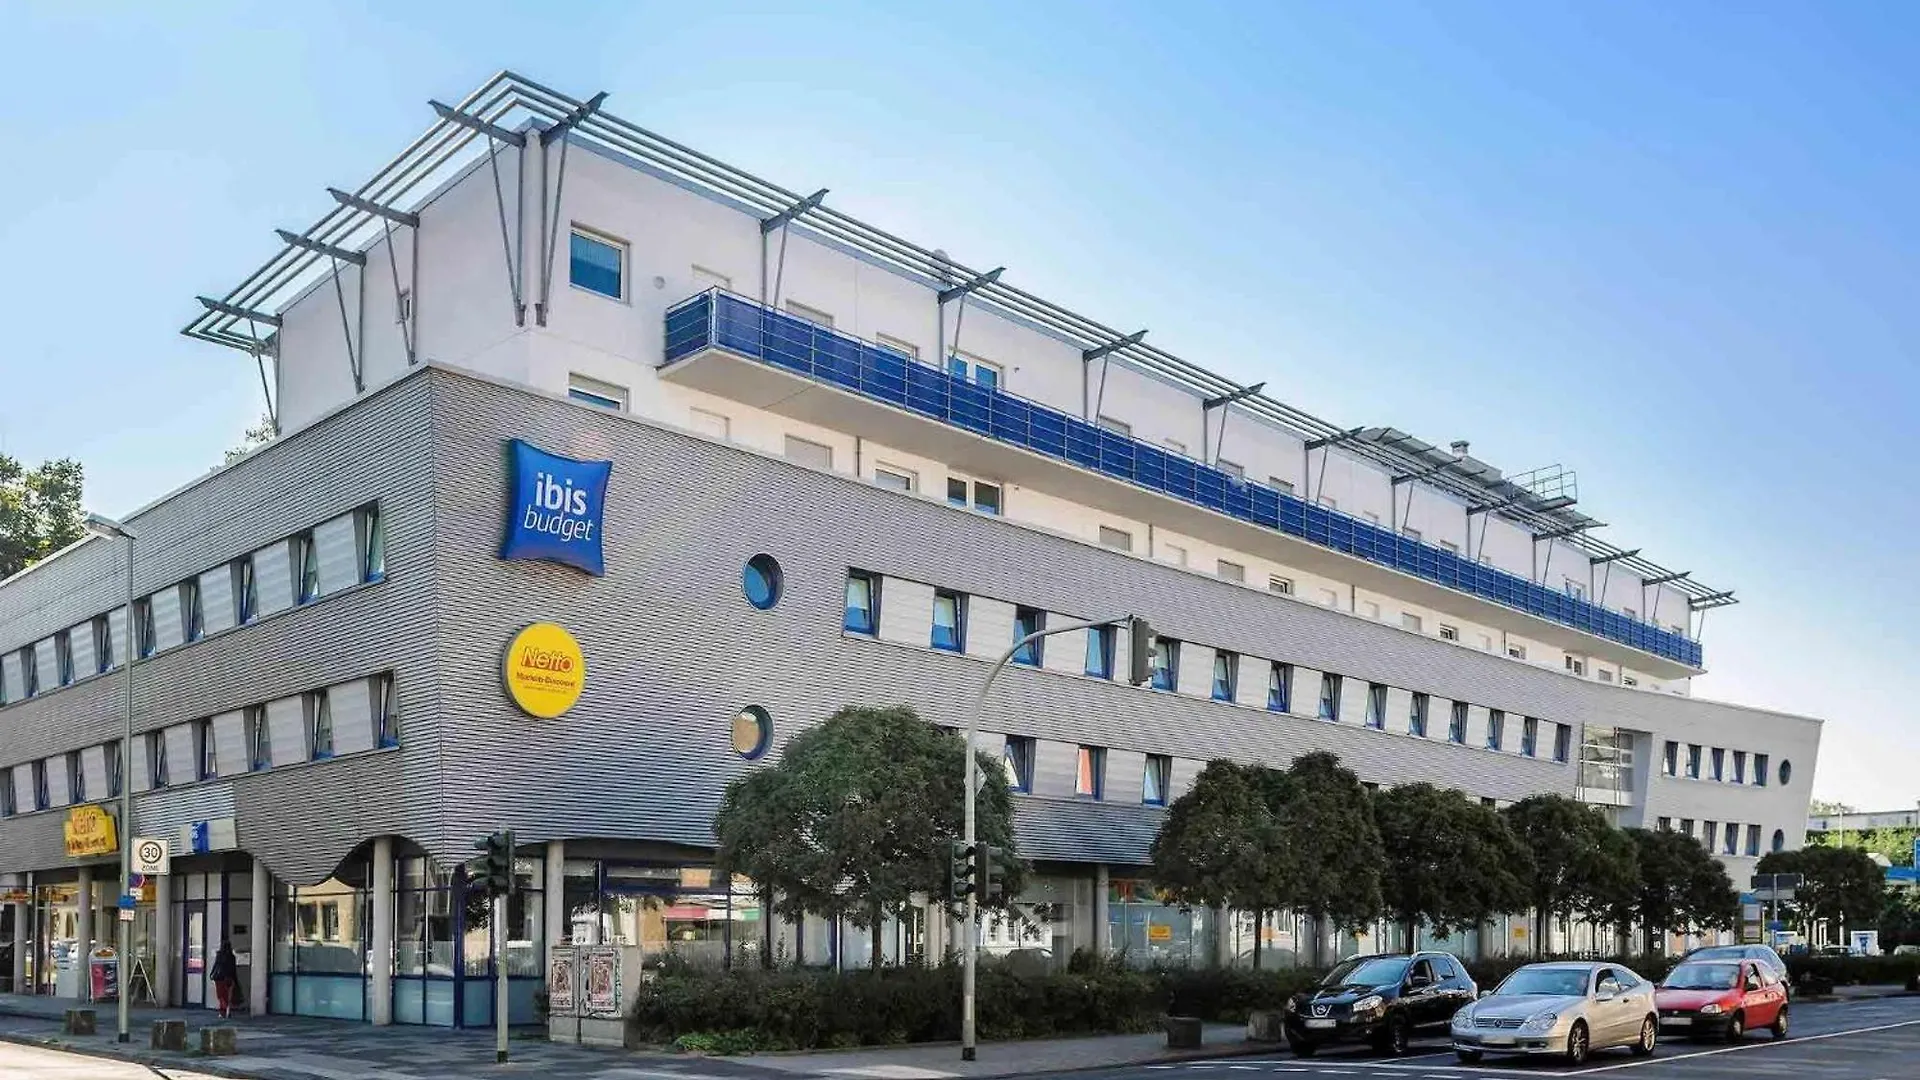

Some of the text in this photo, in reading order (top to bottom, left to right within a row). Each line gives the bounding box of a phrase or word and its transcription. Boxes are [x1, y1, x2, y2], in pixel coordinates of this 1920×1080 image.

[536, 472, 587, 515] ibis
[524, 504, 594, 541] budget
[520, 646, 573, 673] Netto
[143, 847, 158, 859] 30
